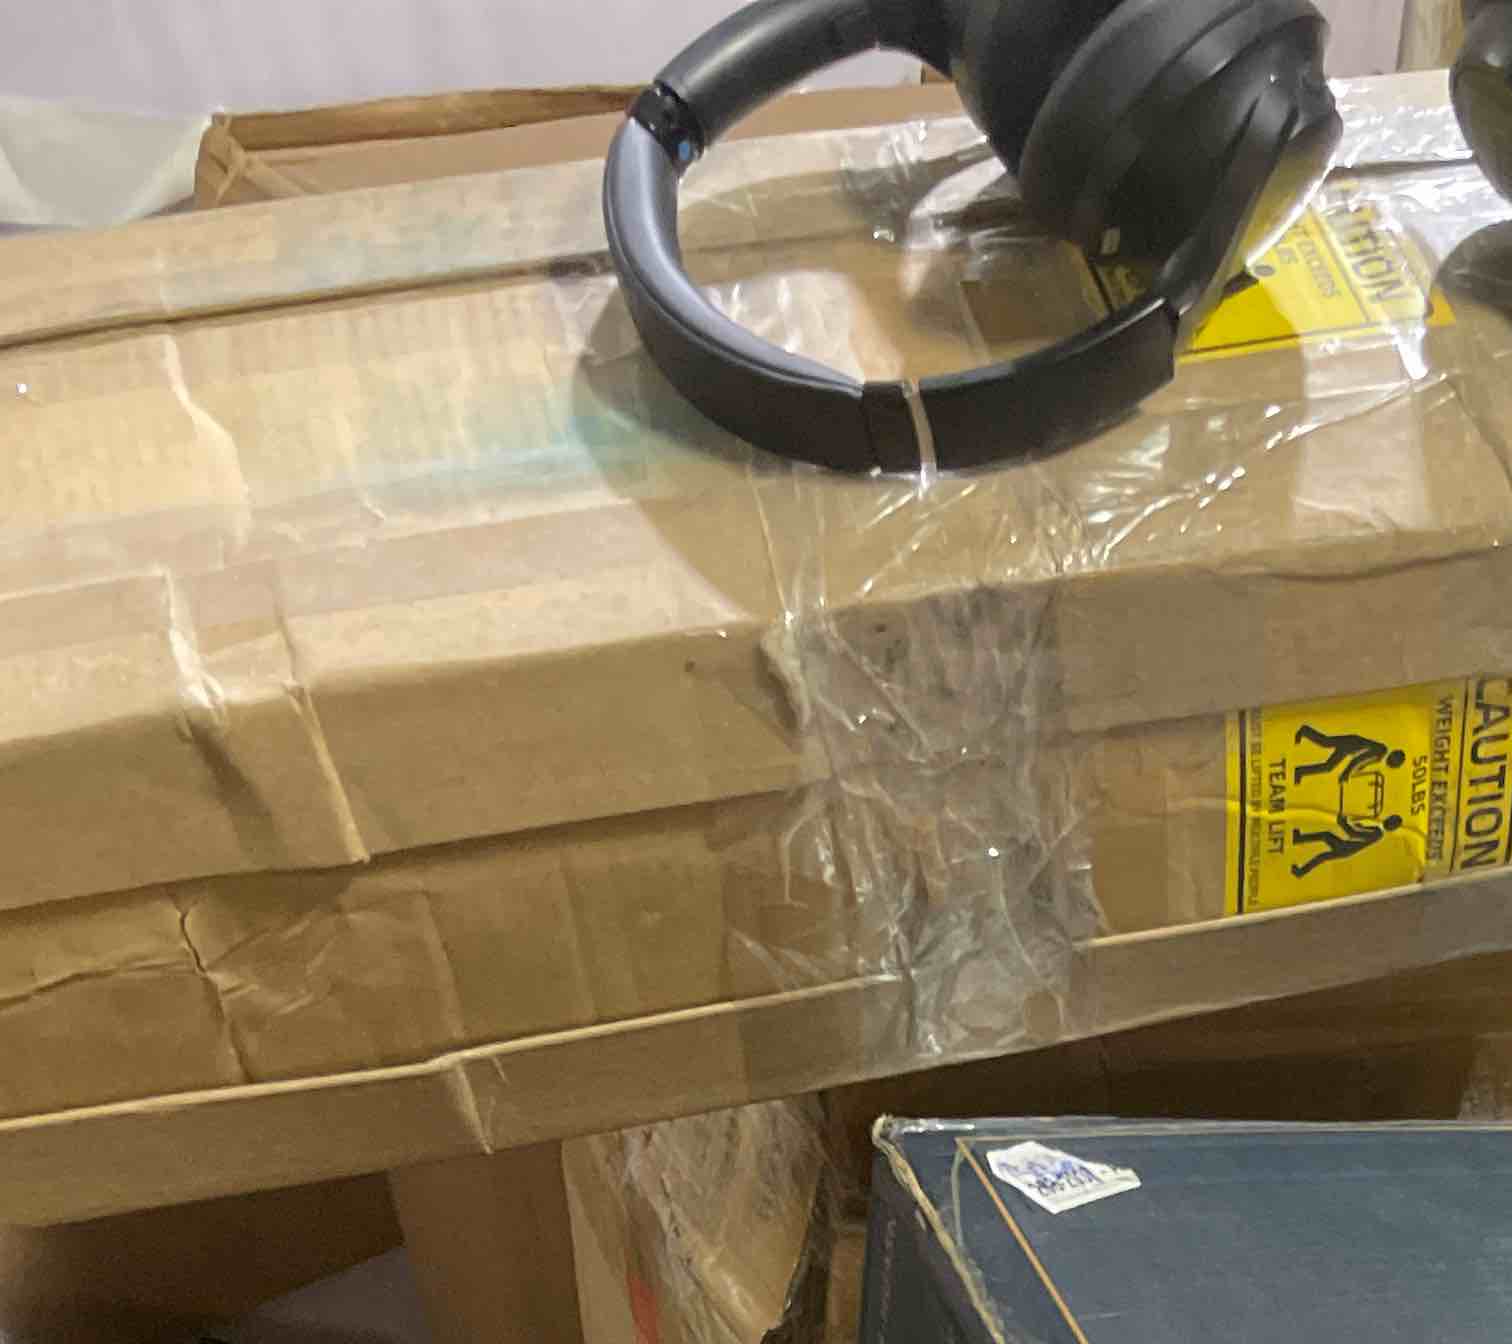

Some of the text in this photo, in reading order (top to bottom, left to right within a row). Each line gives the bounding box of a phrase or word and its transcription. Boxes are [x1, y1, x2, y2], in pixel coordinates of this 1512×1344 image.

[1431, 696, 1453, 773] WEIGHT
[1266, 757, 1287, 855] TEAM LIFT
